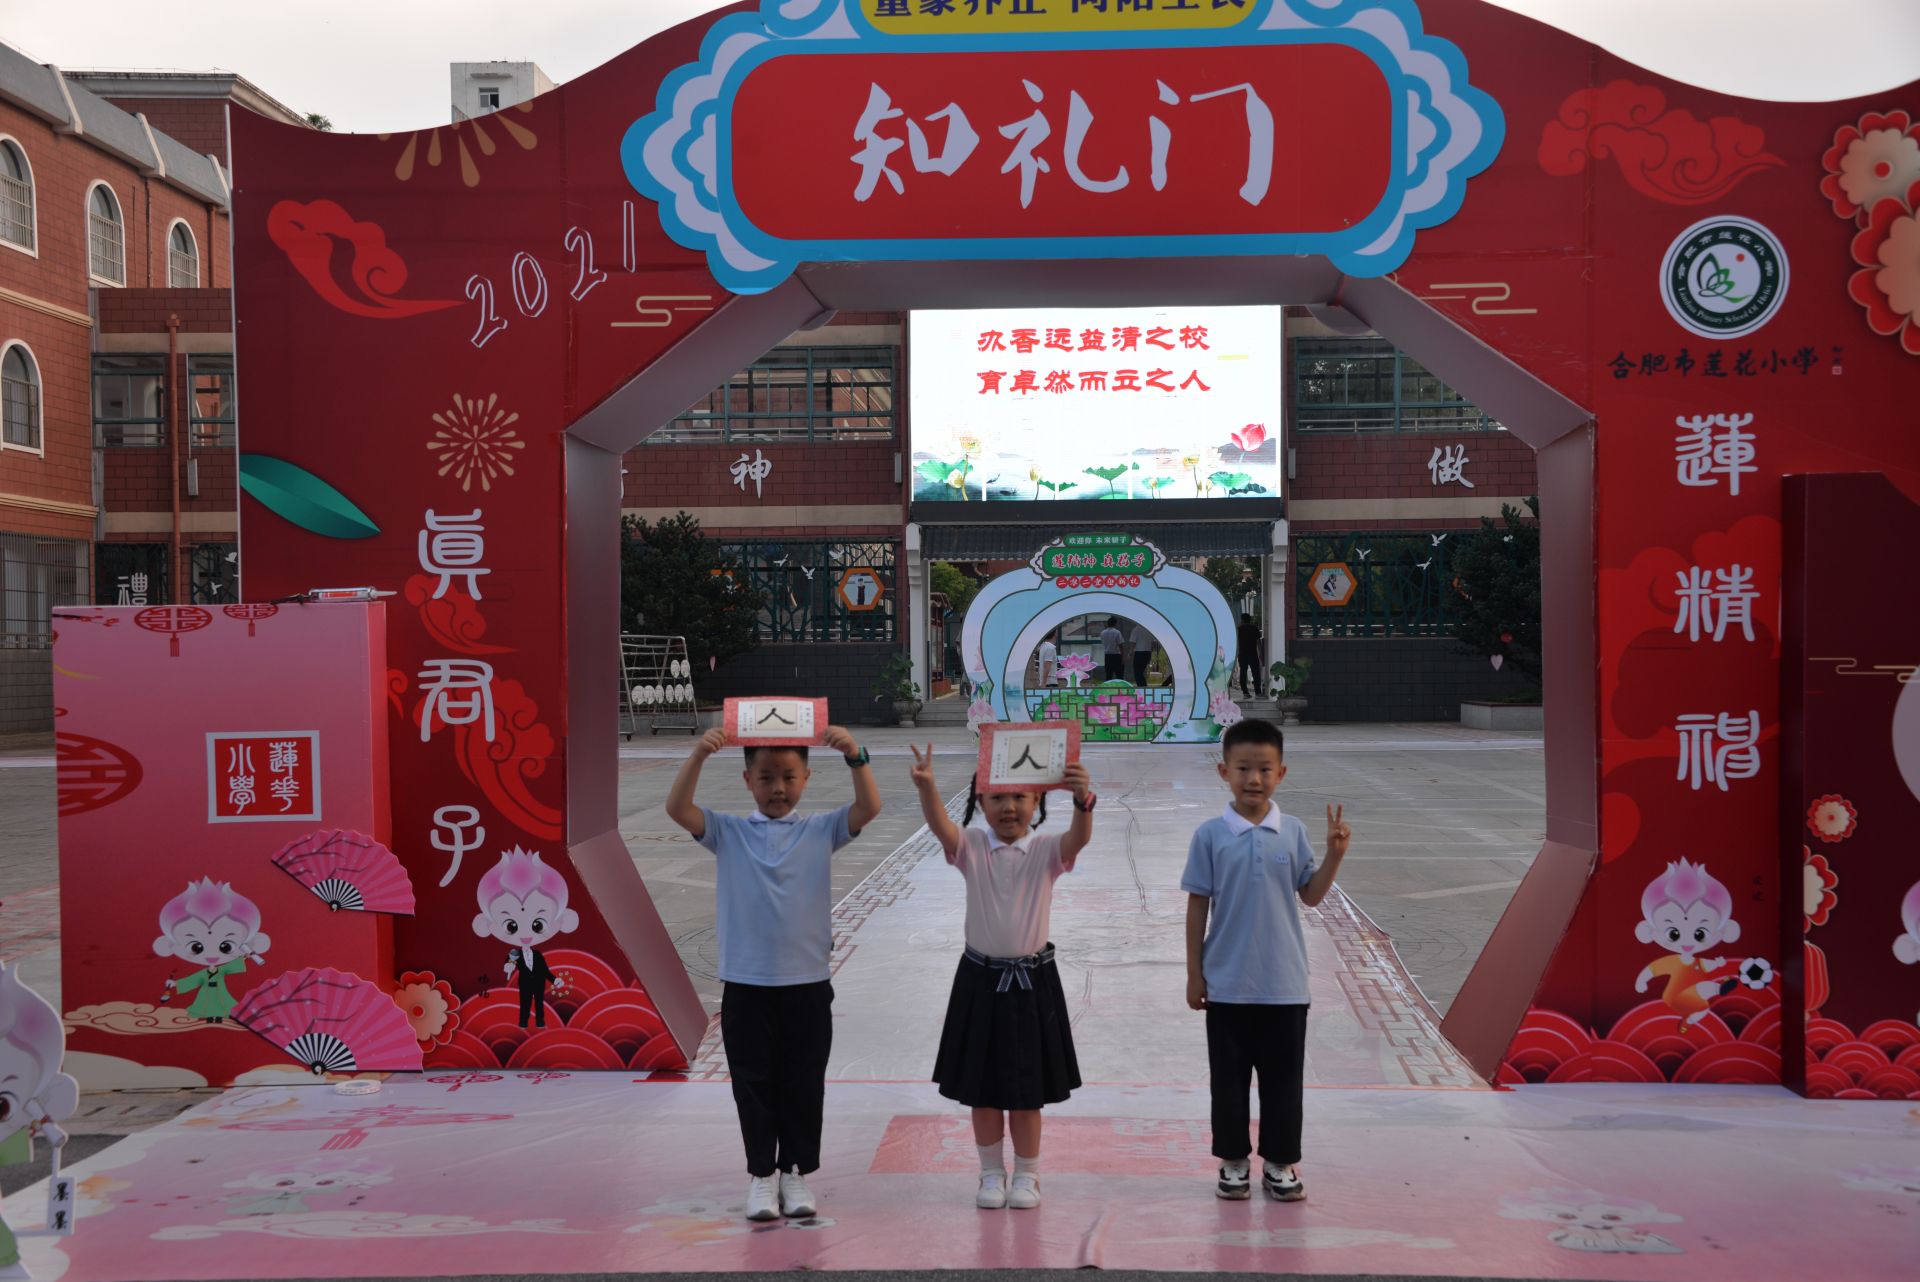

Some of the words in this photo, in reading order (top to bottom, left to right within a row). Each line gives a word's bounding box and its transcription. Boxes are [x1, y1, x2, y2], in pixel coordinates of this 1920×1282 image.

[851, 79, 1275, 209] 知礼门
[465, 200, 636, 349] 2021
[1724, 310, 1749, 323] School
[977, 325, 1211, 354] 办香远益清之校
[976, 367, 1212, 395] 育卓然而立之人
[729, 448, 773, 499] 神
[1427, 443, 1475, 489] 做
[757, 707, 795, 725] 人
[1010, 744, 1047, 770] 人
